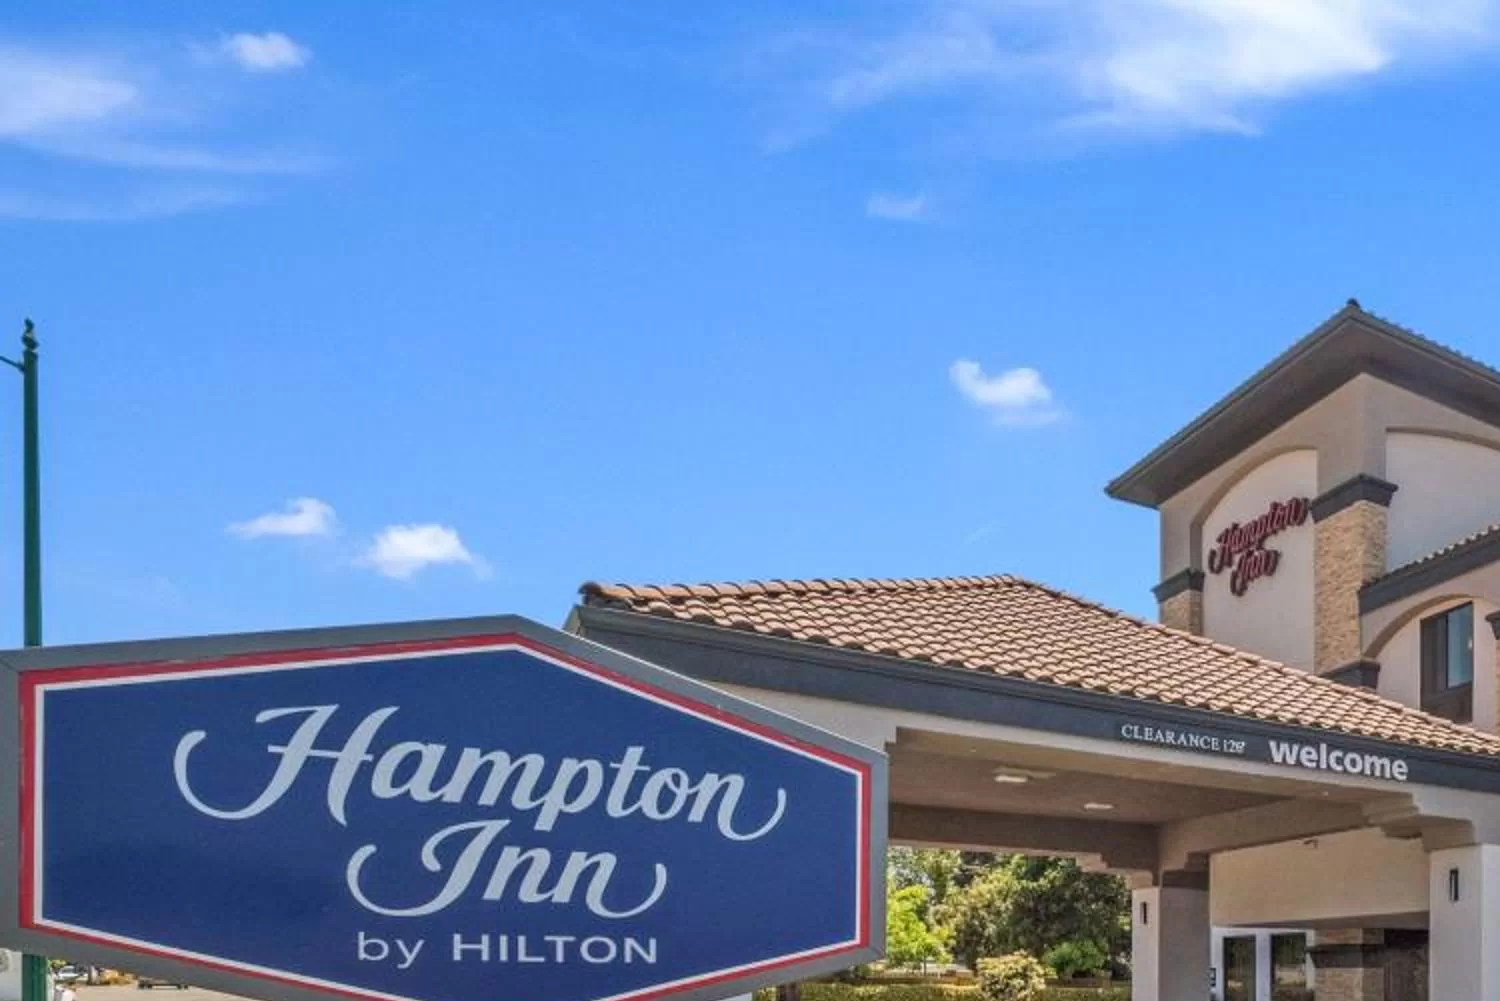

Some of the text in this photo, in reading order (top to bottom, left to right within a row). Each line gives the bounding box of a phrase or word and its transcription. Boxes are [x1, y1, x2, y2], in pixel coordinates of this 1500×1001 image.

[1208, 497, 1309, 574] Hampton
[1230, 549, 1282, 597] Inn
[1121, 723, 1220, 751] CLEARANCE
[173, 704, 786, 841] Hampton
[346, 819, 667, 919] Inn
[358, 931, 658, 969] by HILTON
